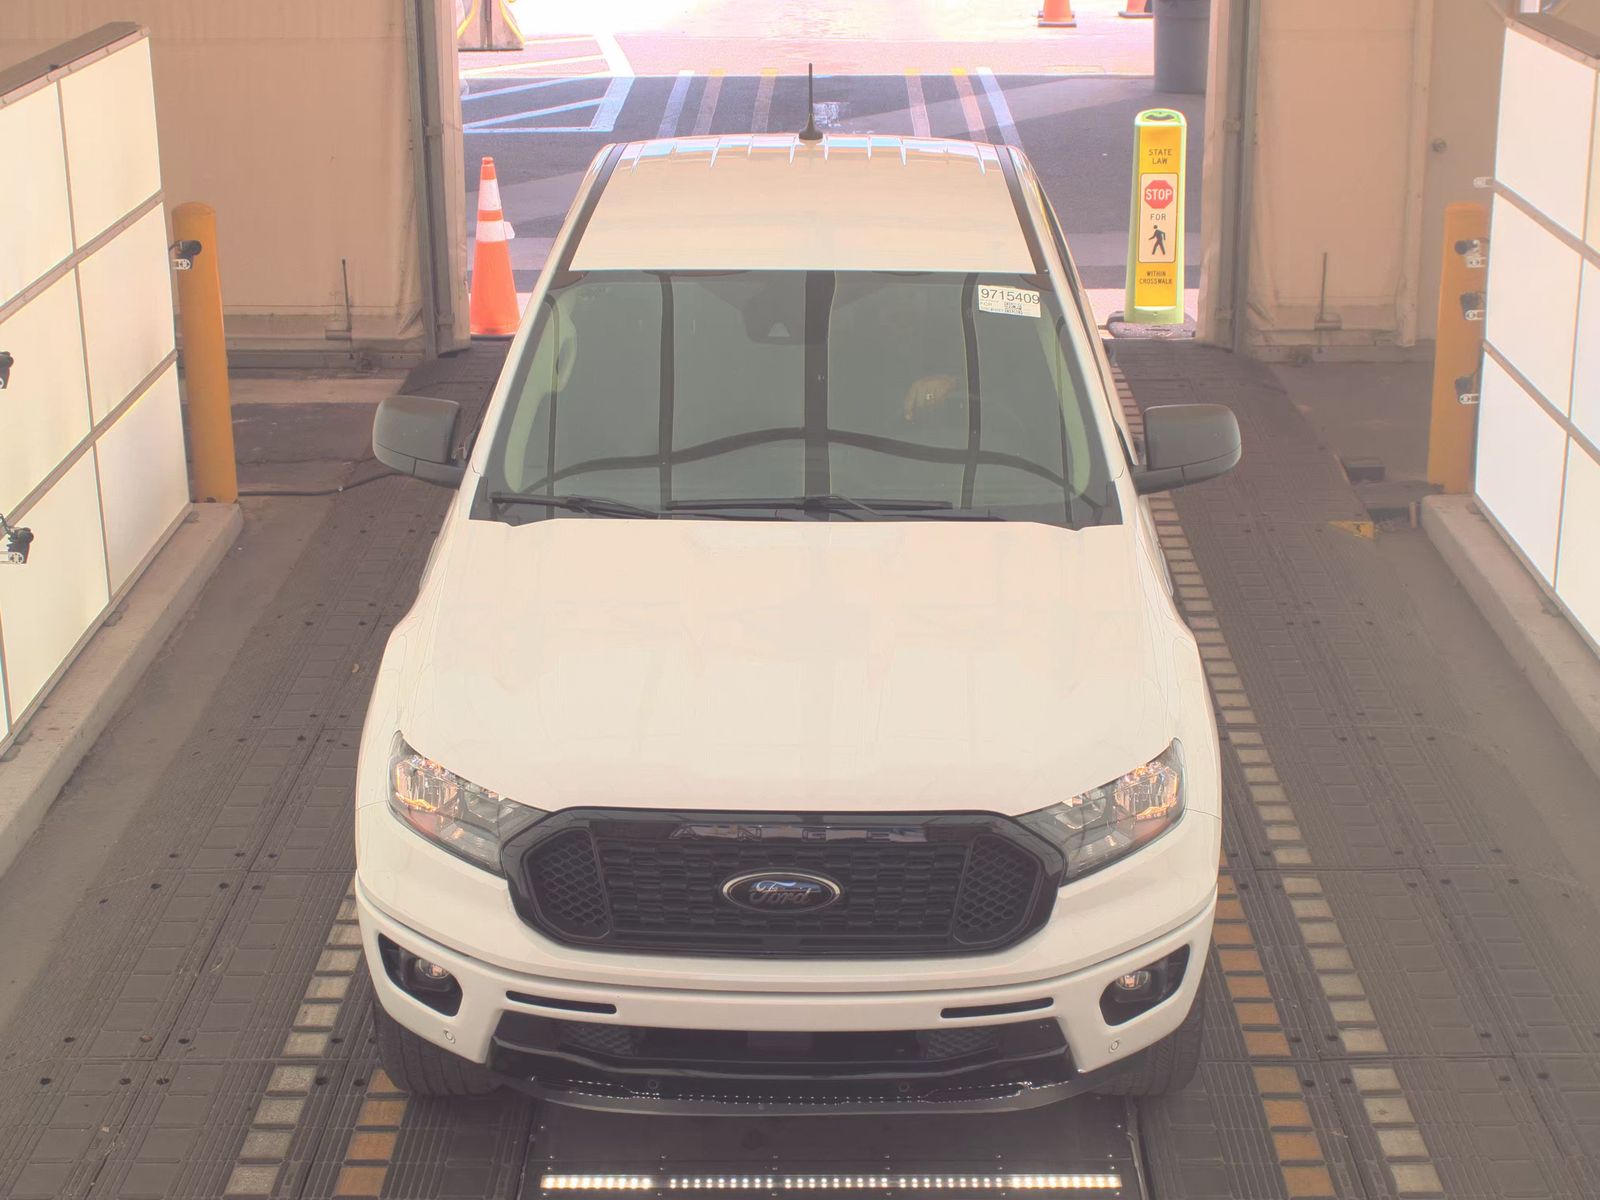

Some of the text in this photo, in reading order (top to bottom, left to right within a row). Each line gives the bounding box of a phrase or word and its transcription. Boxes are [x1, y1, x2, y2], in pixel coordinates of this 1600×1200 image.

[1148, 148, 1173, 156] STATE
[1152, 157, 1168, 165] LAW
[1145, 188, 1173, 201] STOP
[1150, 213, 1167, 221] FOR
[1139, 277, 1173, 285] CROSSWALK
[981, 288, 1040, 305] 9715409
[749, 880, 814, 905] Ford
